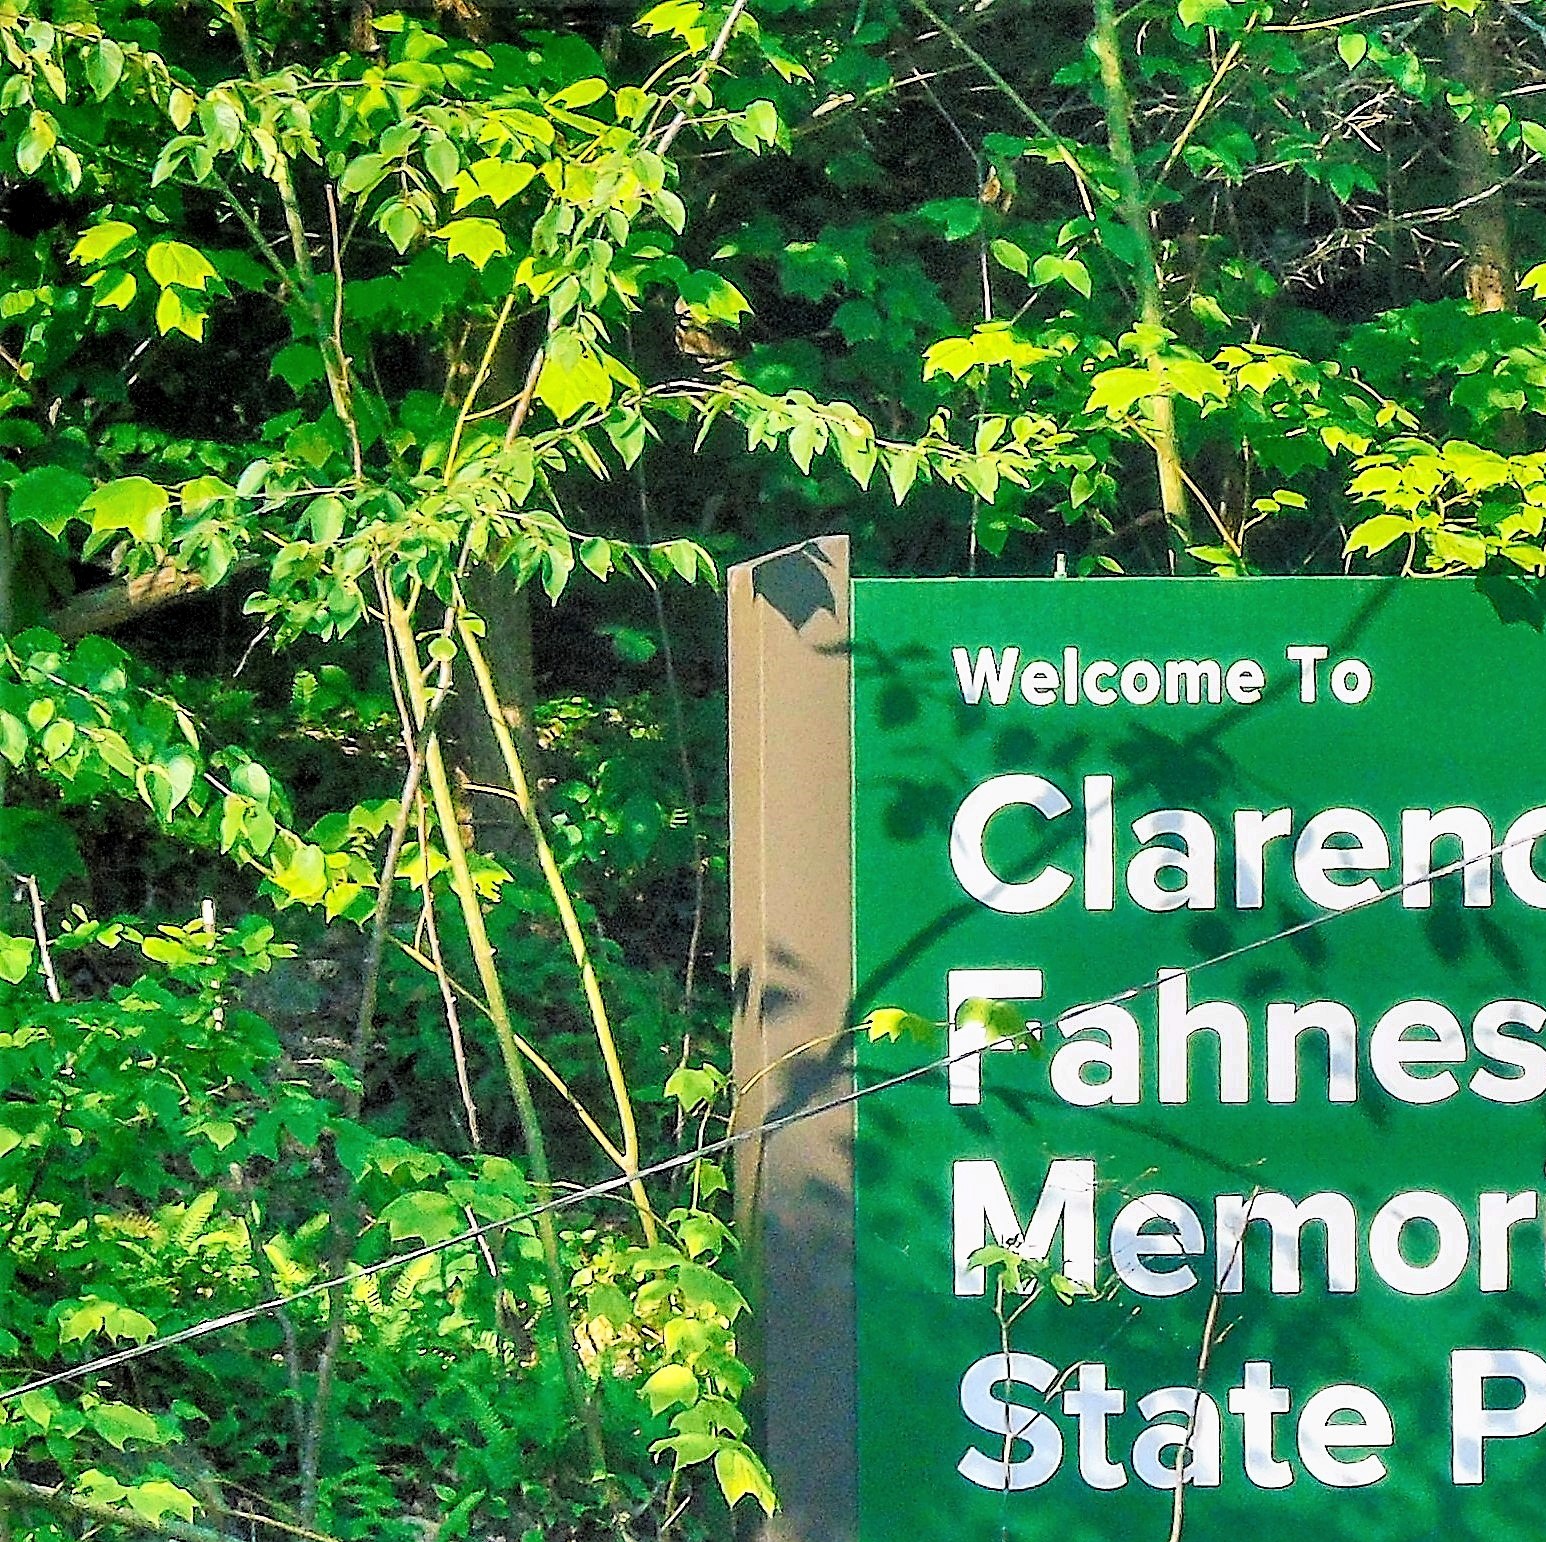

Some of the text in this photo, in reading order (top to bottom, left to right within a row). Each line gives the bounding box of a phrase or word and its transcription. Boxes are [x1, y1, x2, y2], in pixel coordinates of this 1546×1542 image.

[952, 645, 1372, 707] Welcome To
[956, 1346, 1395, 1491] State
